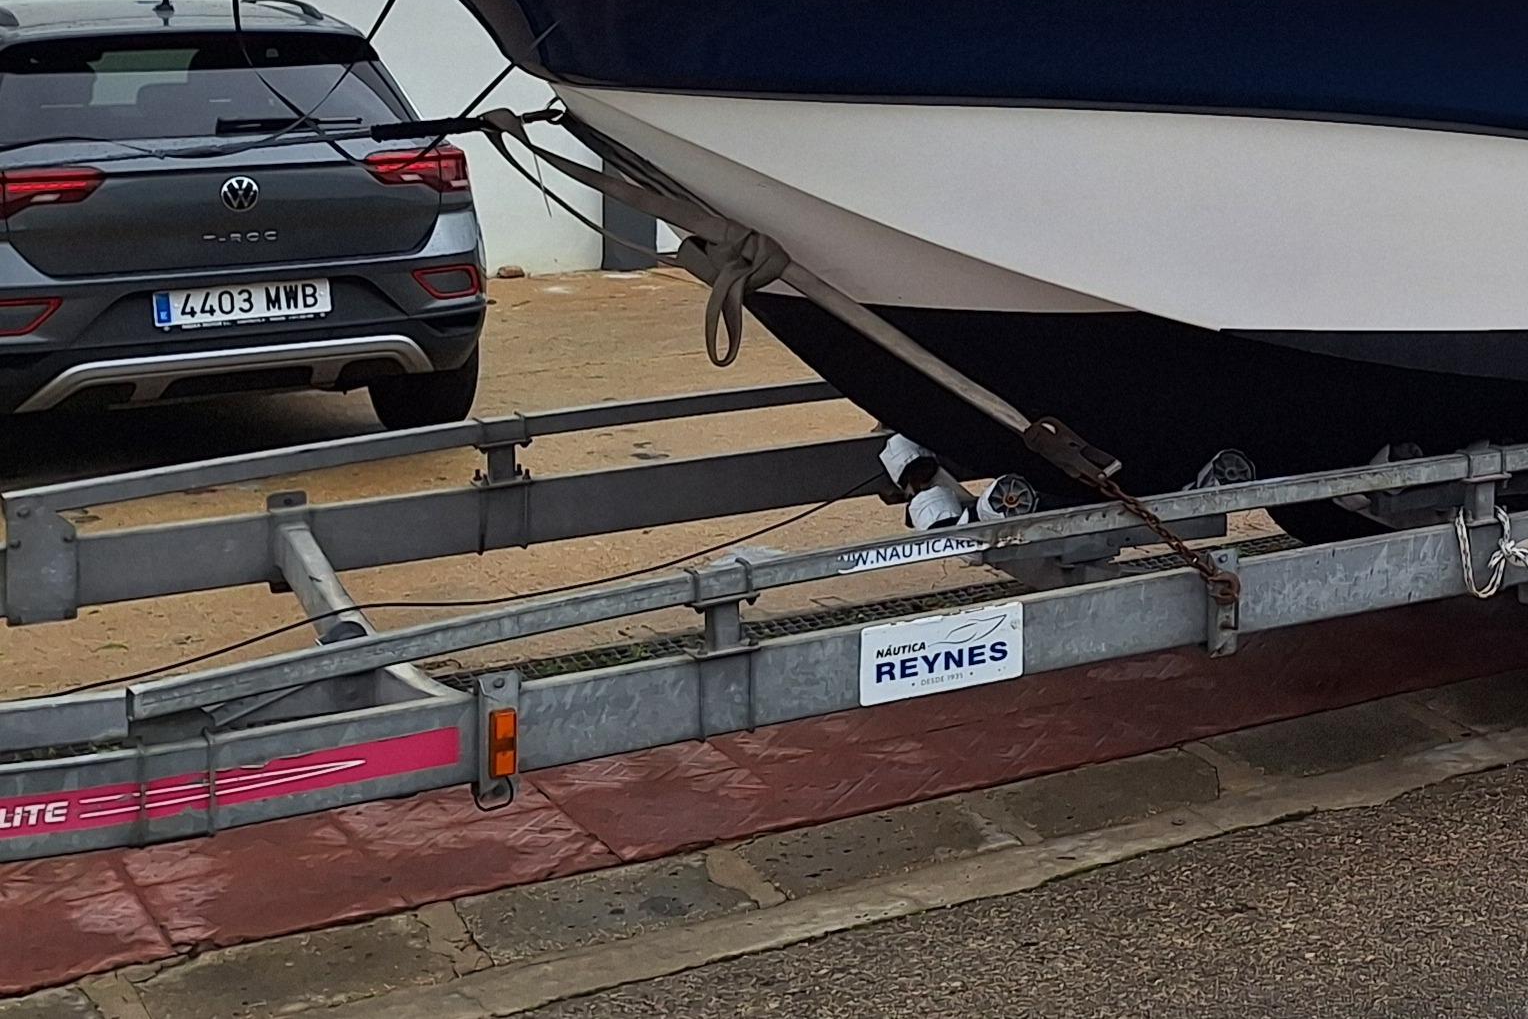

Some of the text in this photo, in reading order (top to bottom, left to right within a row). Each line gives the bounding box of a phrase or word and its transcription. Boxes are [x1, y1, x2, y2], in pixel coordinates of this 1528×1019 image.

[180, 288, 254, 318] 4403
[264, 283, 318, 312] MWB
[875, 641, 1008, 684] REYNES
[876, 642, 926, 659] NÁUTICA
